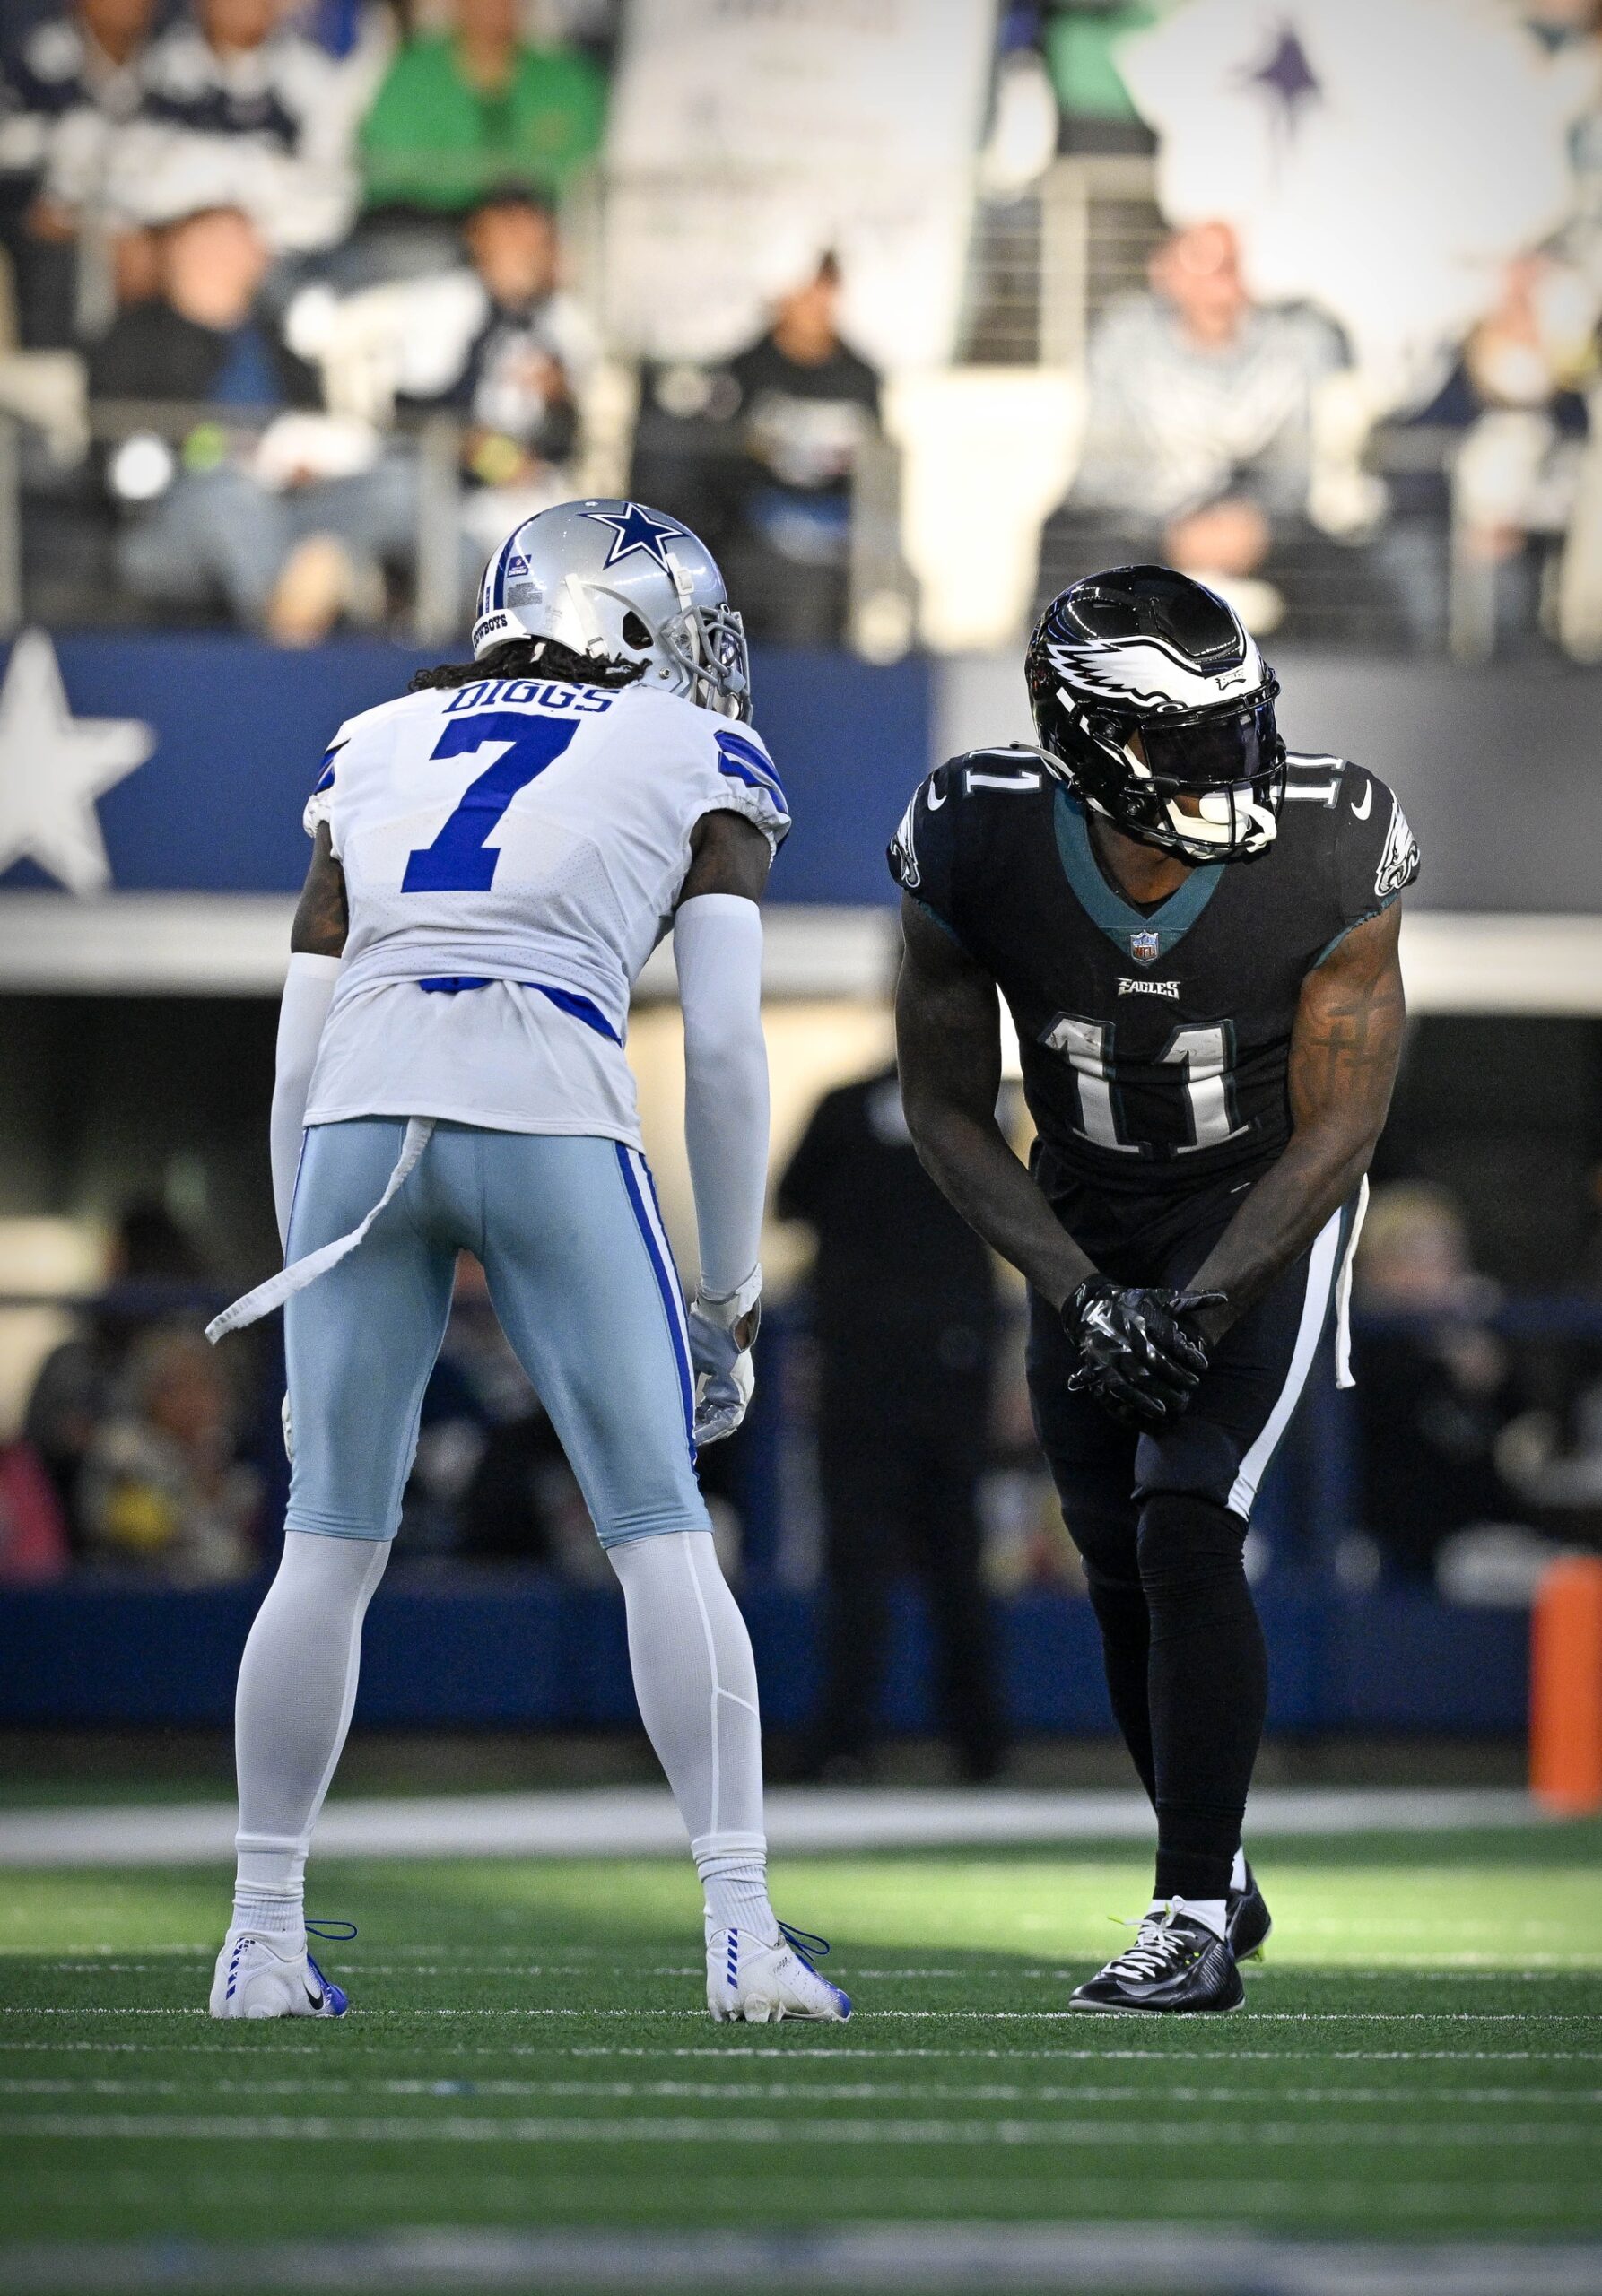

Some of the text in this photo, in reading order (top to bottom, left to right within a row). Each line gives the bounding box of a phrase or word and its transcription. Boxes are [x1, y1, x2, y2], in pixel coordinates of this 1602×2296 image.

[474, 613, 508, 648] COWBOYS
[442, 679, 621, 714] DIGGS
[401, 711, 581, 893] 7
[1116, 977, 1181, 1000] EAGLES
[1037, 1013, 1252, 1155] 11
